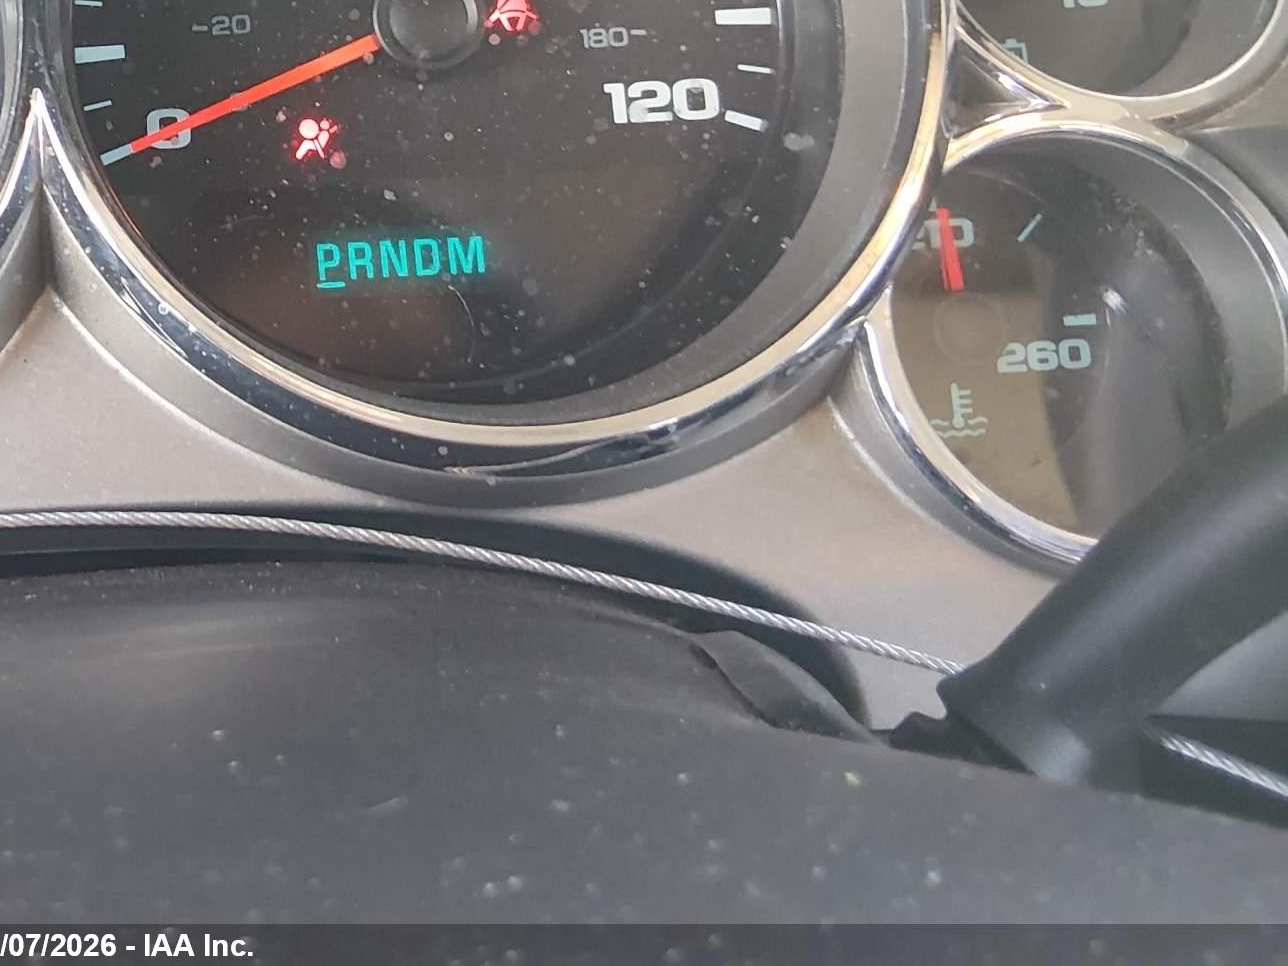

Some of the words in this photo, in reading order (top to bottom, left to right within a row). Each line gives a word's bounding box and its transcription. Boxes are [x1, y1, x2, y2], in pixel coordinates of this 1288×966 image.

[212, 14, 250, 36] 20
[580, 27, 628, 49] 180
[603, 78, 720, 124] 120
[997, 338, 1092, 374] 260
